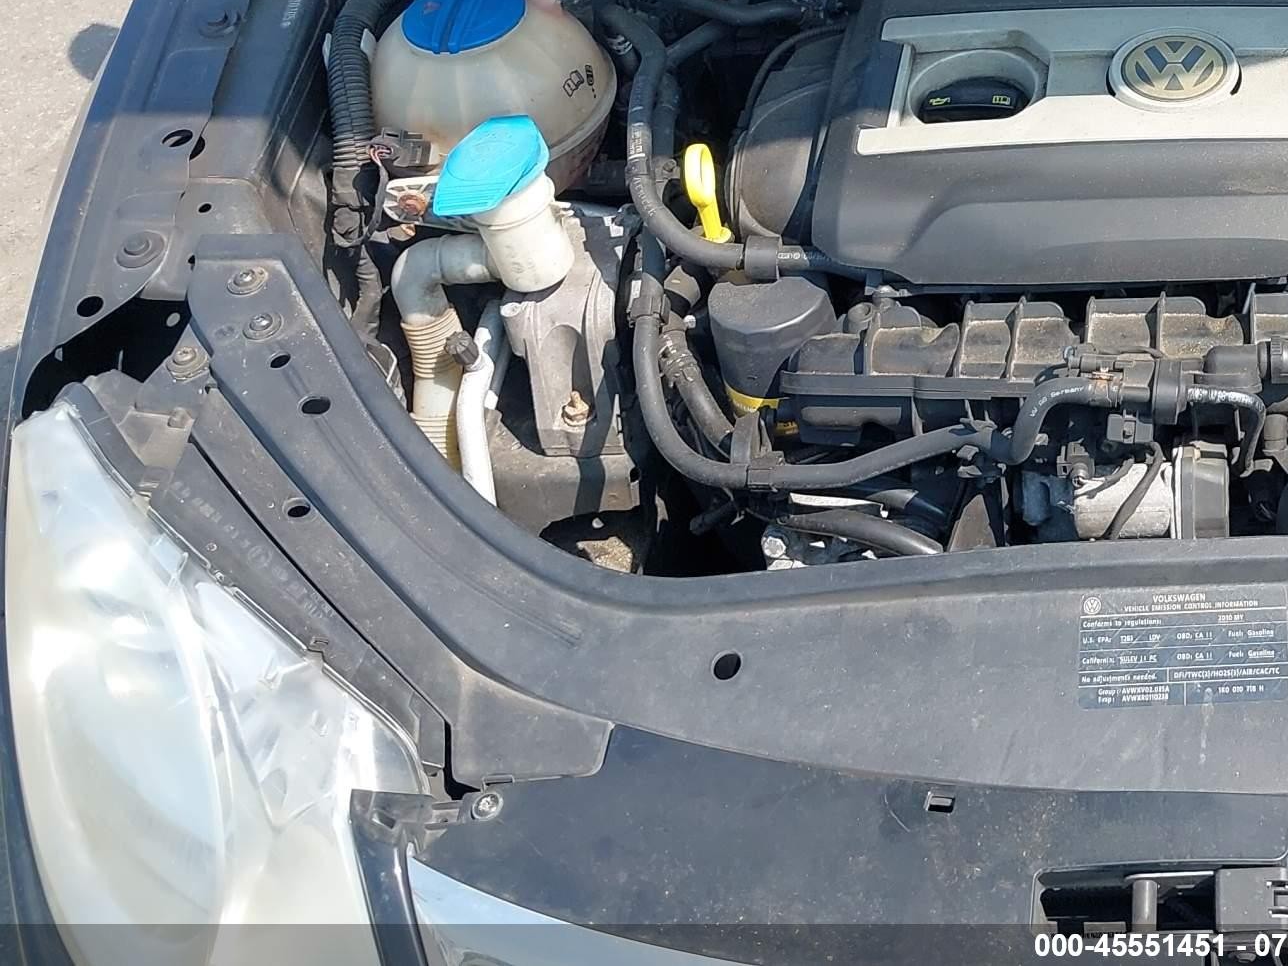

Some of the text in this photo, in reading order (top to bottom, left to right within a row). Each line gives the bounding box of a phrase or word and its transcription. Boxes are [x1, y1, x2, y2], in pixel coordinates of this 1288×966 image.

[1152, 593, 1206, 603] VOLKSWAGEN
[1184, 602, 1212, 610] CONTROL
[1215, 600, 1259, 608] INFORMATION
[1083, 620, 1112, 628] Conforms
[1247, 628, 1274, 636] Gasoline
[1247, 649, 1275, 657] Gasoline
[1081, 675, 1090, 683] No
[1093, 673, 1131, 683] adjustments
